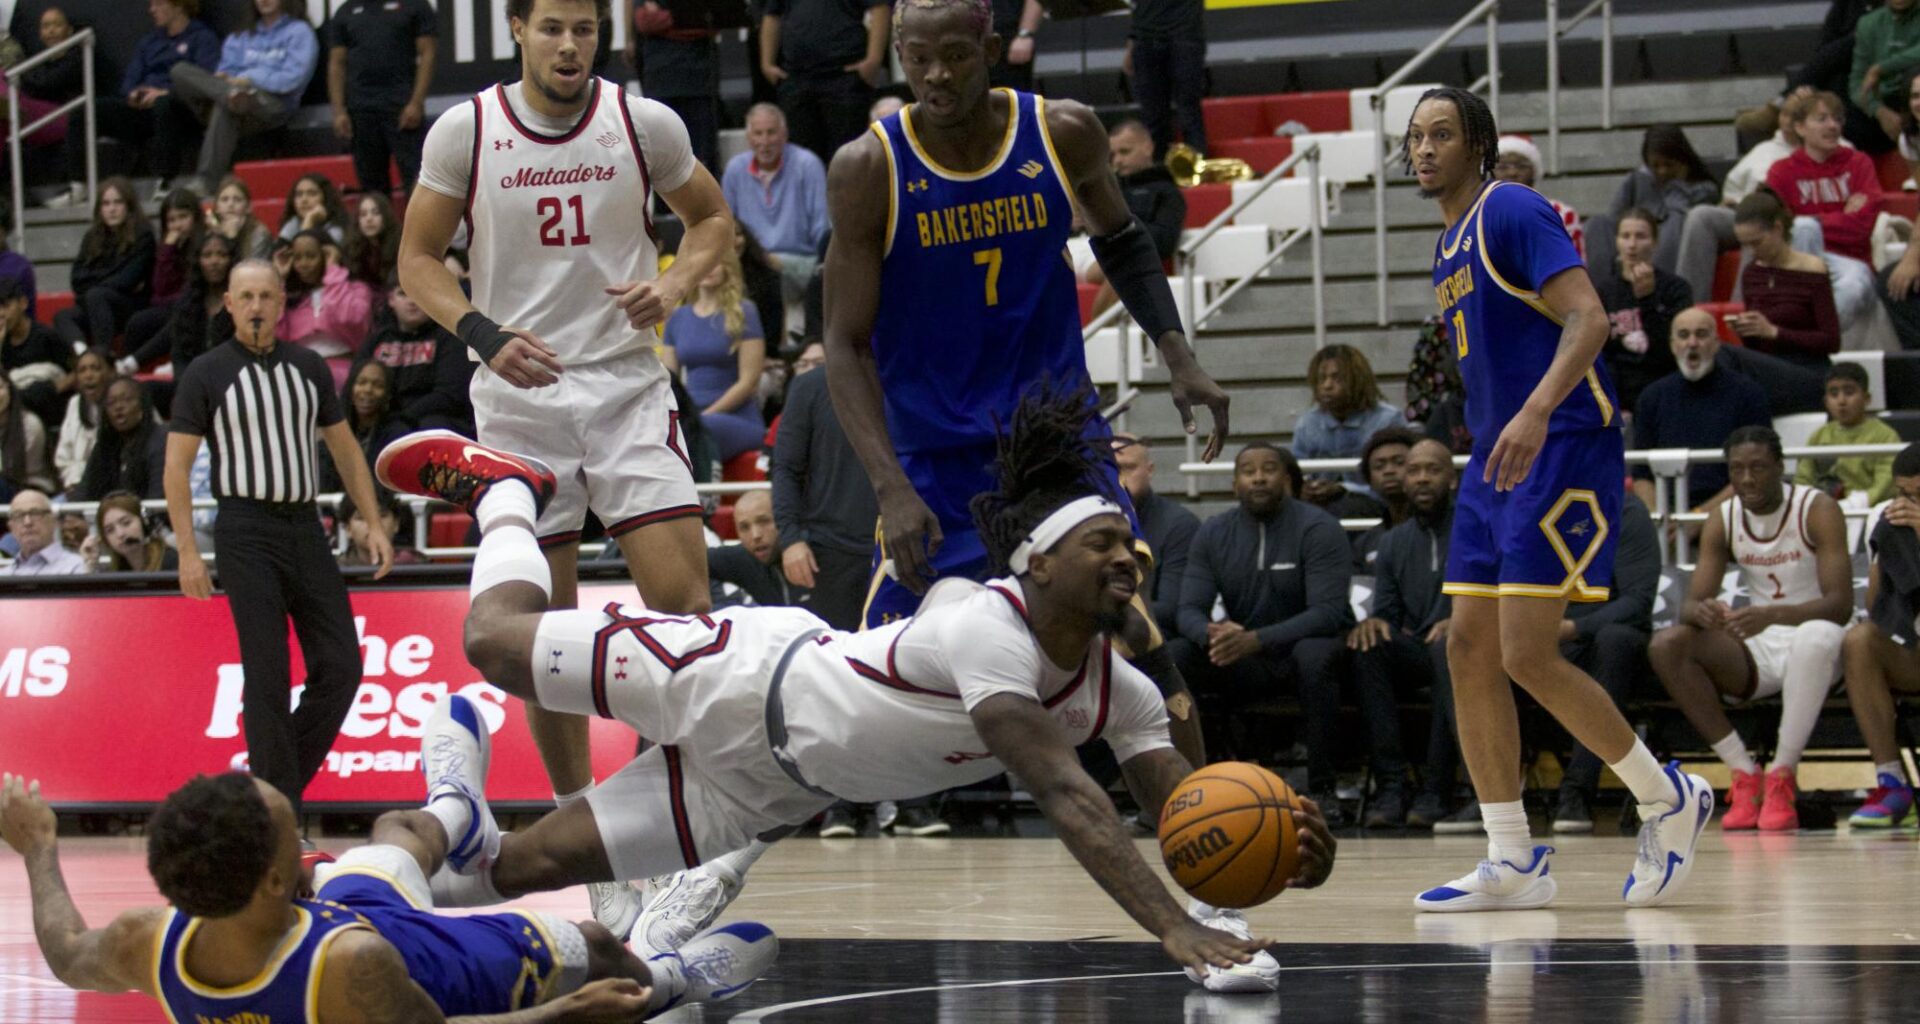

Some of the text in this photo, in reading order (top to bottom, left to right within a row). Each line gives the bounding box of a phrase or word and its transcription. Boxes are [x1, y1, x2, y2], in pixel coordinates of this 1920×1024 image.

[500, 163, 618, 189] Matadors
[536, 194, 592, 247] 21
[916, 192, 1049, 248] BAKERSFIELD
[973, 247, 1003, 307] 7
[1767, 572, 1787, 599] 1
[354, 616, 434, 677] he
[205, 664, 507, 739] Pess
